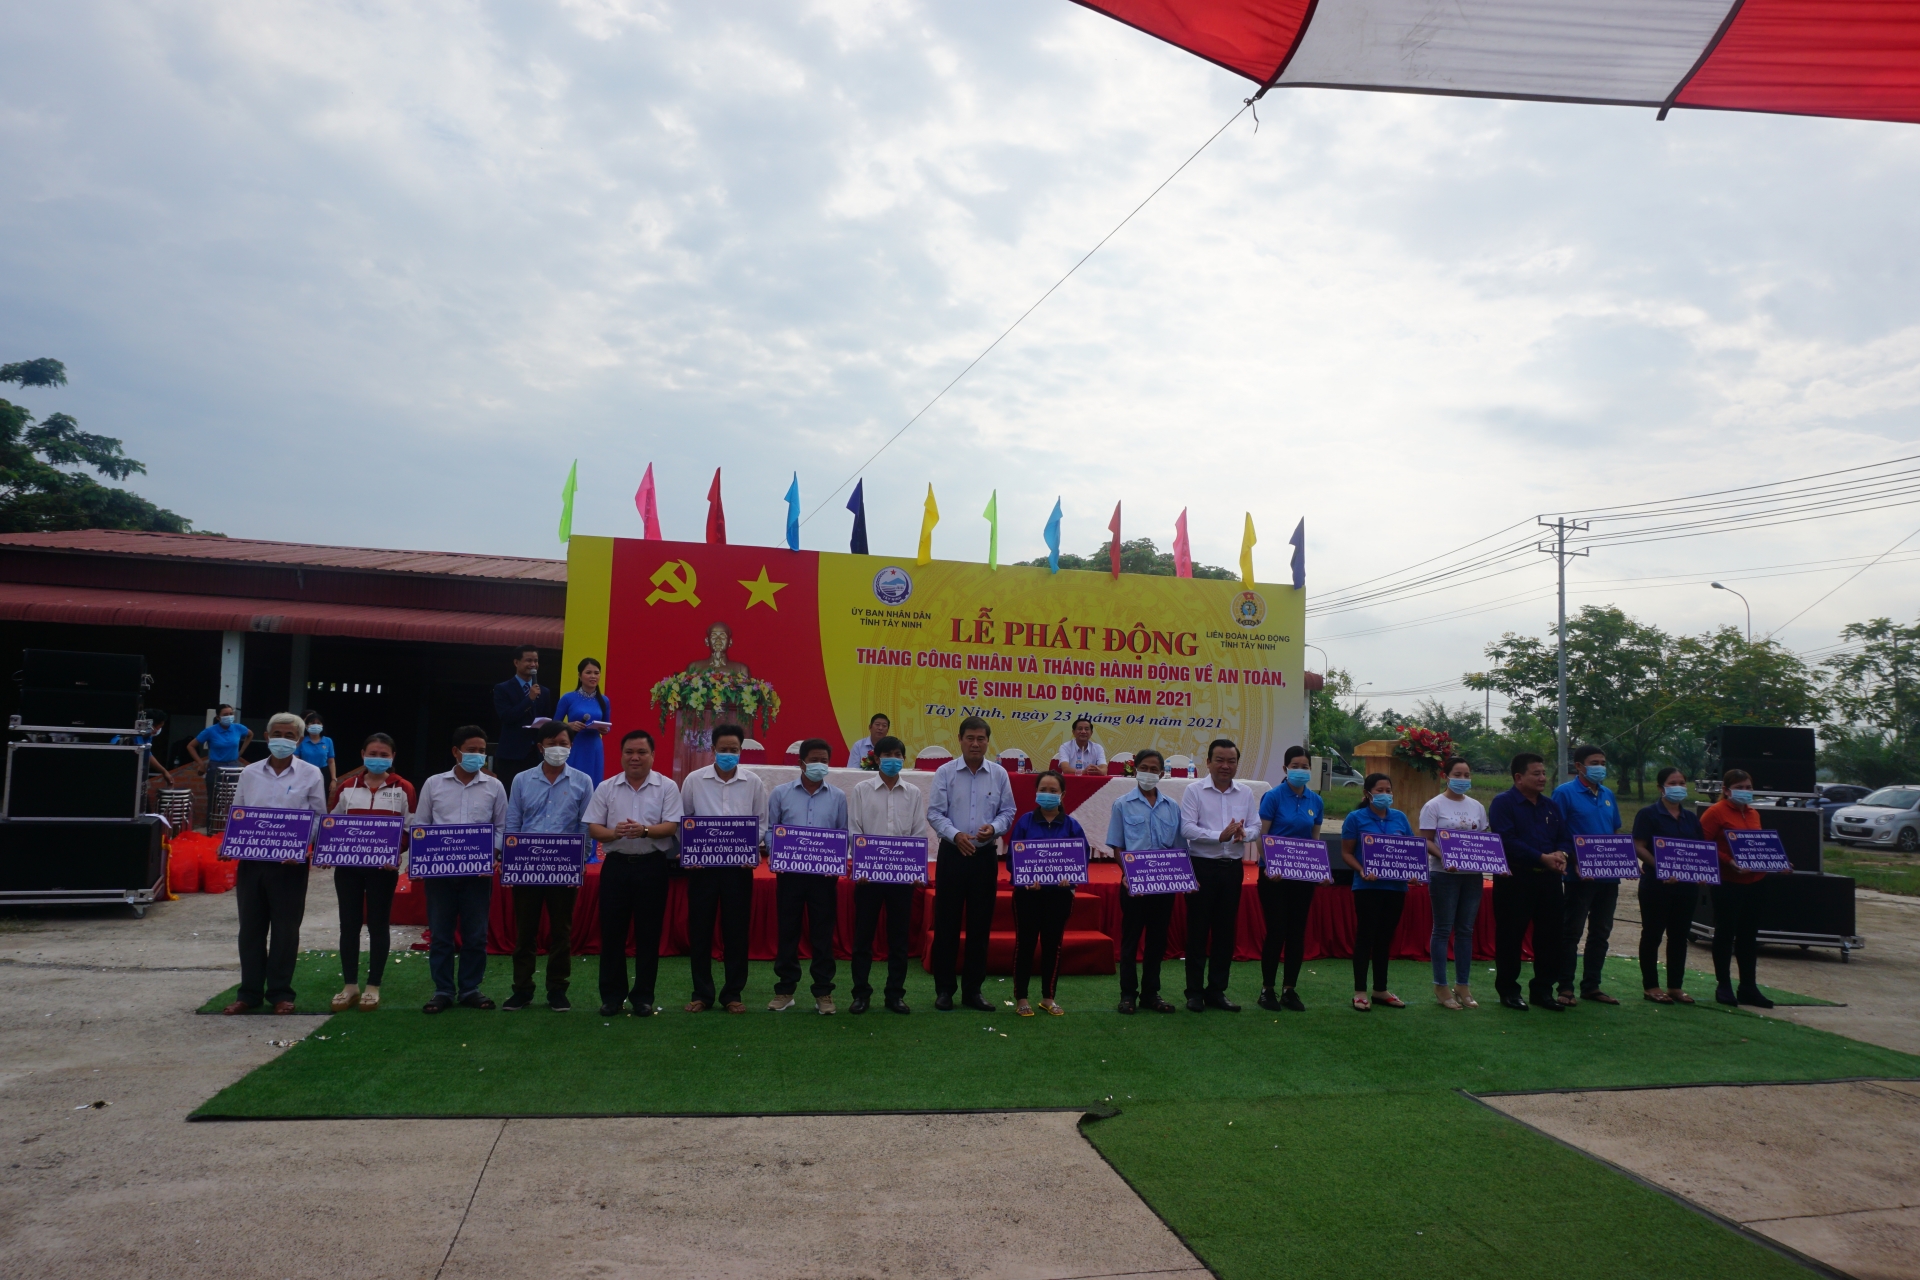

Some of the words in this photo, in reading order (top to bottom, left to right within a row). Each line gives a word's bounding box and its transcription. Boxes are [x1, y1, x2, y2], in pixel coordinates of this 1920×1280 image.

[866, 609, 884, 617] BAN
[886, 609, 911, 619] NHÂN
[913, 611, 932, 620] DÂN
[884, 619, 899, 627] TÂY
[902, 620, 922, 628] NINH
[950, 607, 995, 645] LỄ
[1003, 617, 1096, 650] PHÁT
[1102, 622, 1199, 660] ĐỘNG
[1206, 630, 1224, 640] LIÊN
[1226, 631, 1248, 640] ĐOÀN
[1250, 633, 1265, 642] LAO
[1267, 633, 1290, 643] ĐỘNG
[1240, 641, 1255, 650] TÂY
[1257, 642, 1276, 650] NINH
[856, 646, 912, 666] THÁNG
[917, 649, 962, 669] CÔNG
[967, 653, 1013, 672] NHÂN
[1017, 654, 1038, 673] VÀ
[1043, 657, 1095, 676] THÁNG
[1100, 660, 1143, 679] HÀNH
[1147, 663, 1190, 683] ĐỘNG
[1194, 664, 1213, 682] VỀ
[1217, 669, 1239, 684] AN
[1243, 668, 1286, 688] TOÀN,
[958, 678, 978, 699] VỆ
[983, 682, 1022, 698] SINH
[1027, 684, 1057, 700] LAO
[1061, 684, 1110, 704] ĐỘNG,
[1115, 686, 1151, 704] NĂM
[1156, 691, 1192, 706] 2021
[925, 704, 955, 718] Tây
[960, 706, 1006, 720] Ninh,
[1012, 710, 1048, 722] ngày
[1053, 711, 1072, 721] 23
[1077, 712, 1121, 725] tháng
[1126, 714, 1145, 725] 04
[1149, 716, 1182, 726] năm
[1187, 718, 1223, 728] 2021
[253, 819, 286, 829] Trao
[705, 827, 734, 836] Trao
[245, 835, 259, 845] ẤM
[259, 837, 281, 846] CÔNG
[527, 845, 558, 854] Trao
[701, 843, 712, 852] ẤM
[714, 844, 732, 852] CÔNG
[522, 861, 534, 870] ẤM
[536, 863, 555, 871] CÔNG
[1657, 868, 1718, 882] 50000.000đ
